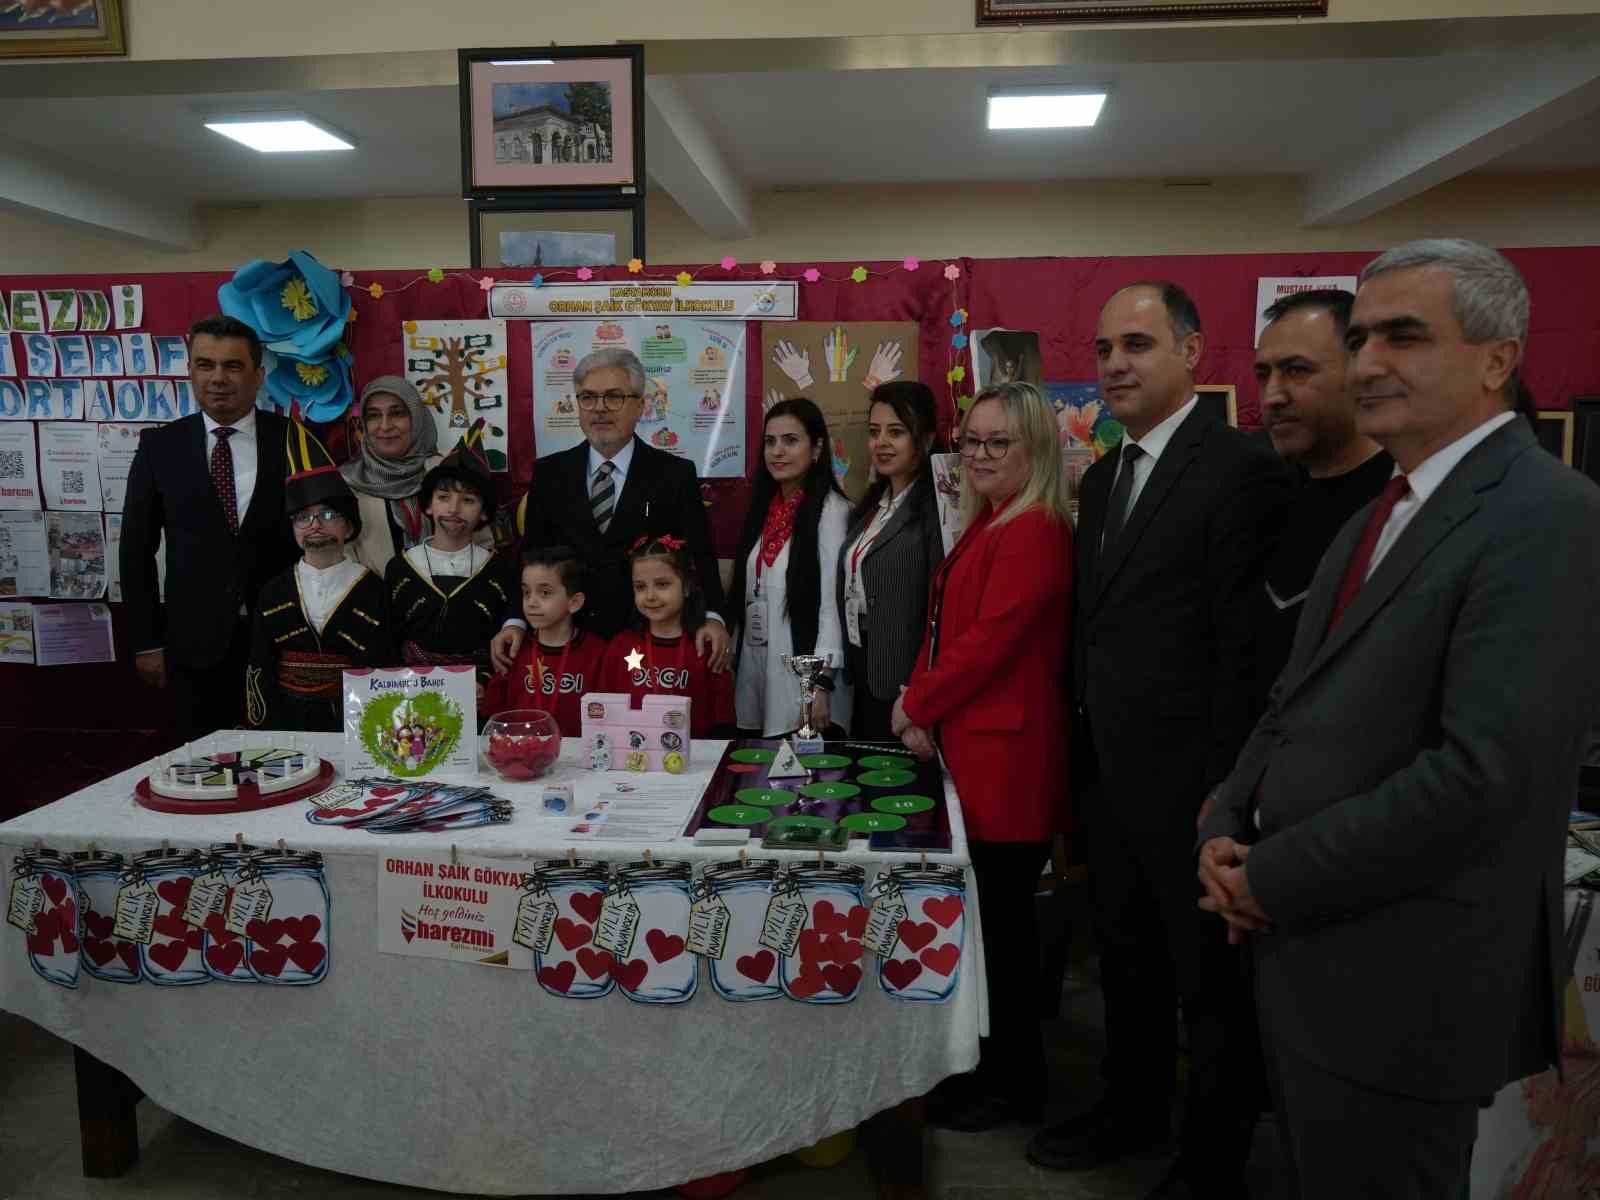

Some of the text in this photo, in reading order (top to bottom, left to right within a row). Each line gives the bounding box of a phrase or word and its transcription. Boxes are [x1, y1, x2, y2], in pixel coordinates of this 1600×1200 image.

[549, 300, 592, 312] ORHAN
[675, 298, 736, 312] İLKOKULU
[386, 858, 434, 877] ORHAN
[438, 862, 470, 882] ŞAİK
[423, 881, 489, 905] İLKOKULU
[417, 919, 495, 948] harezmi
